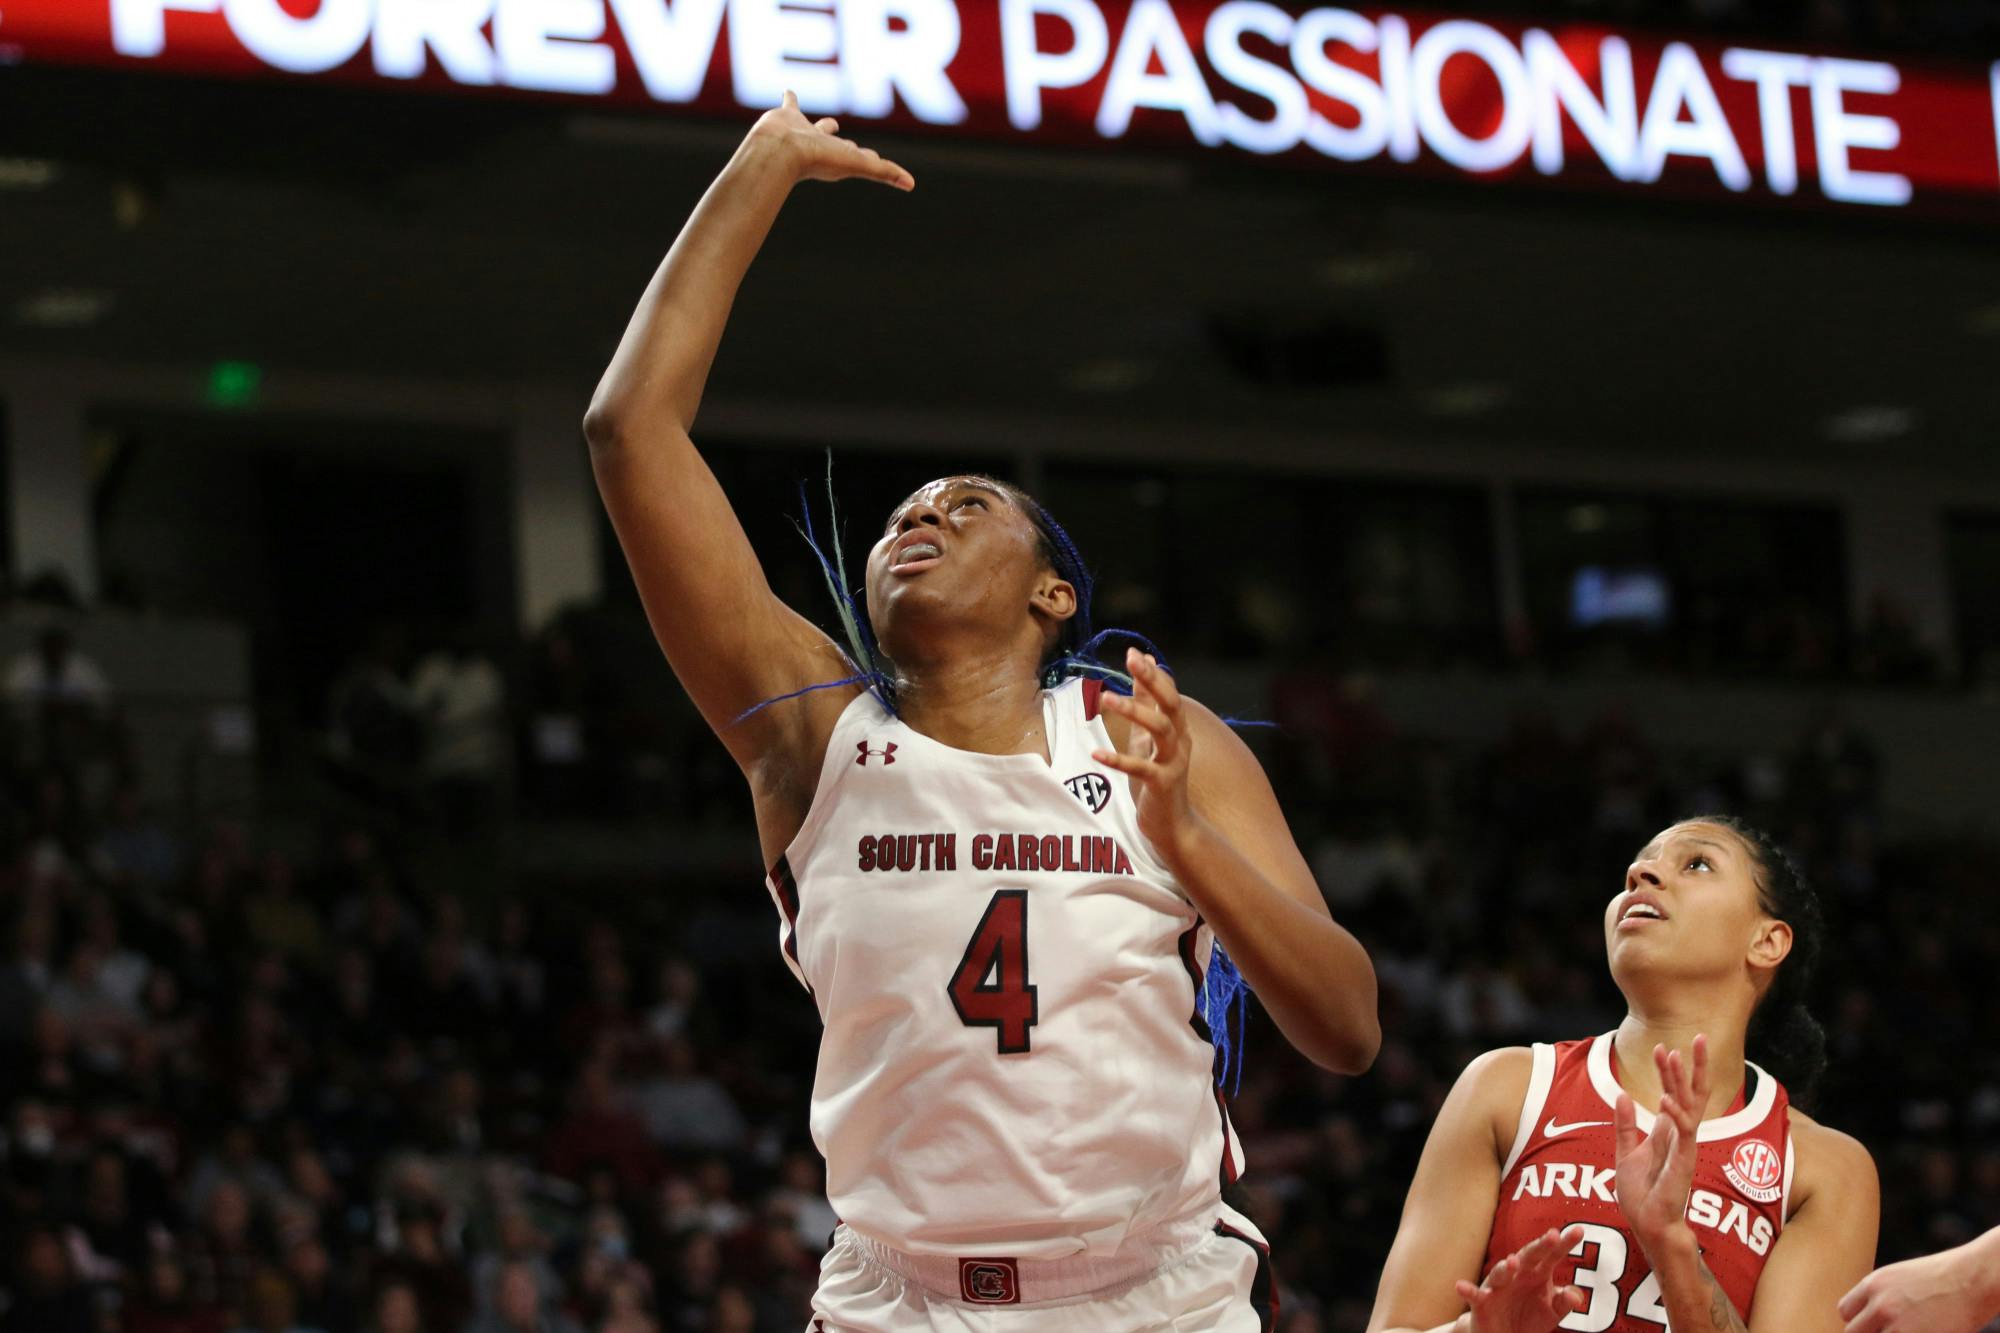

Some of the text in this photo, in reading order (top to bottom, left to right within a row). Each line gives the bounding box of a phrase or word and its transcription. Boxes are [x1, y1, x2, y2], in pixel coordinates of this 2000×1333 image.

[997, 0, 1912, 204] PASSIONATE
[858, 834, 1134, 875] SOUTH CAROLINA
[947, 889, 1038, 1054] 4
[1730, 1174, 1774, 1199] GRADUATE
[1738, 1143, 1777, 1184] SEC
[1512, 1163, 1774, 1256] ARKSAS
